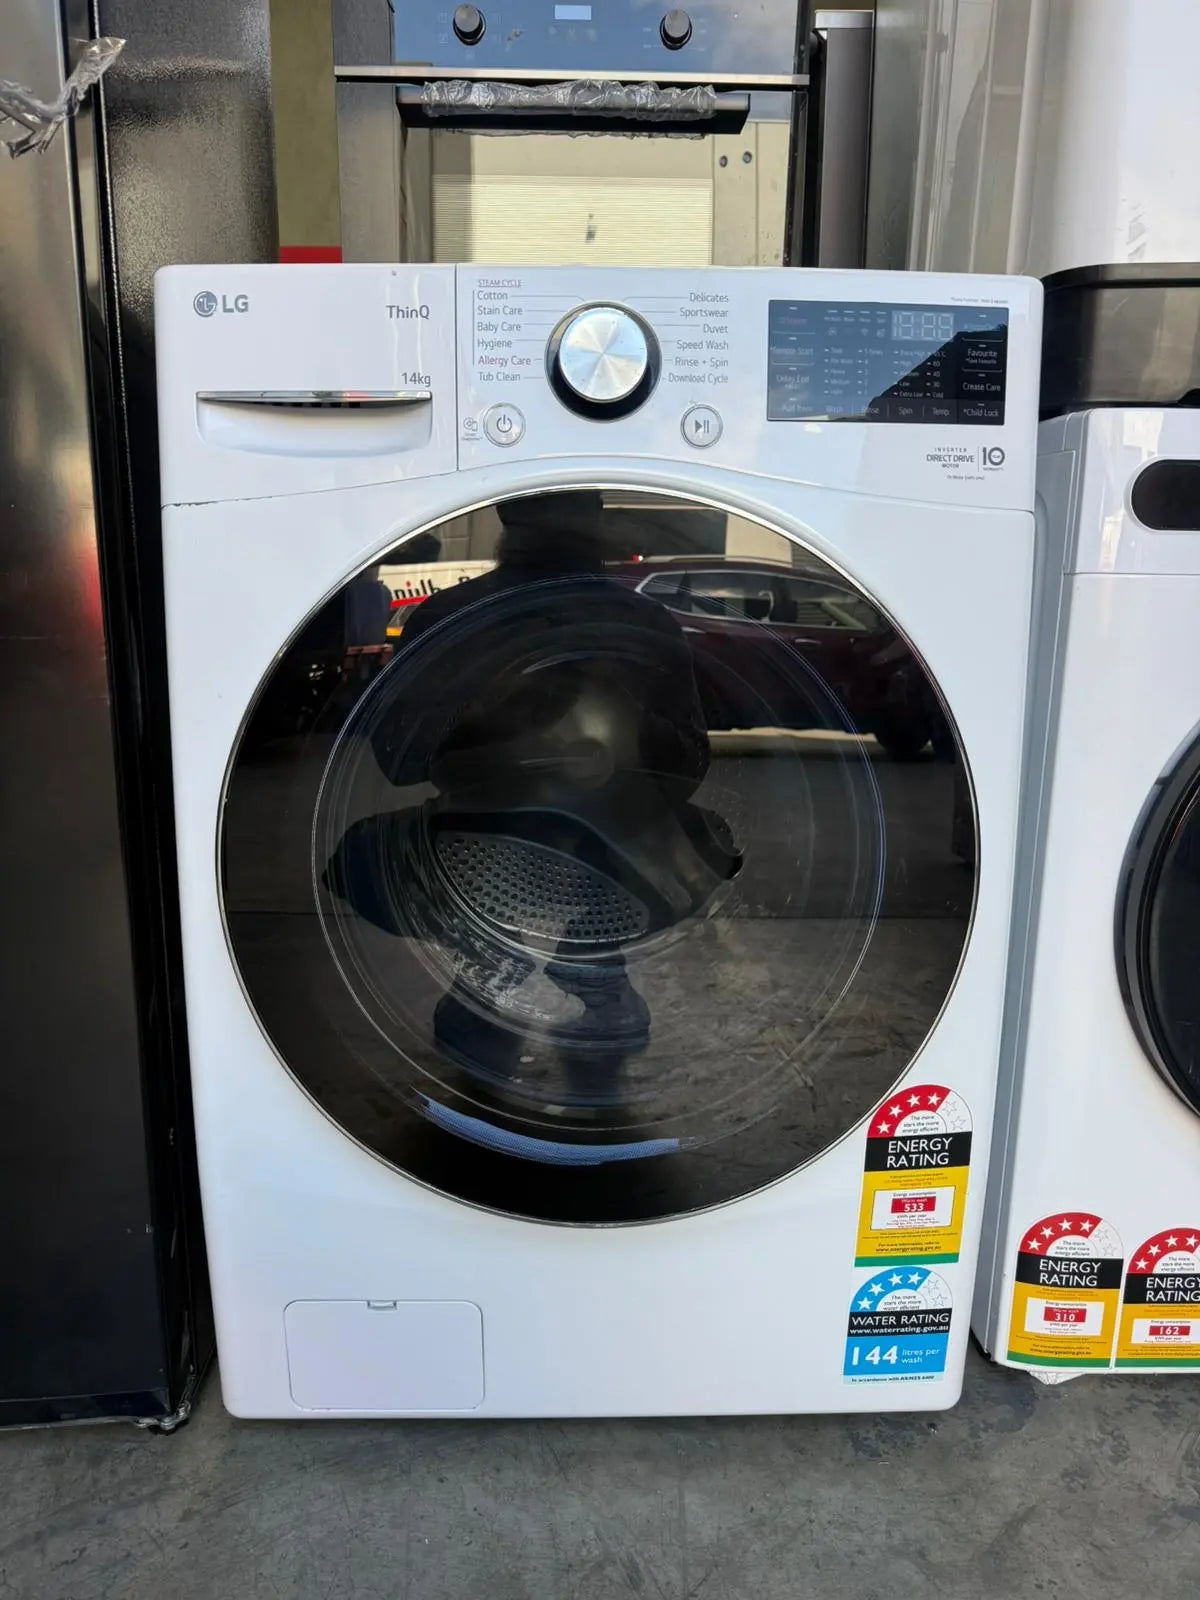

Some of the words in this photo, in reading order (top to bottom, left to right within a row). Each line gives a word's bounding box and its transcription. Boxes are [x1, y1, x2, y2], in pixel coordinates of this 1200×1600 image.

[478, 279, 501, 288] STEAM
[502, 279, 521, 288] CYCLE
[477, 290, 508, 300] Cotton
[689, 292, 729, 303] Delicates
[222, 294, 249, 313] LG
[386, 304, 430, 319] ThinQ
[477, 305, 500, 315] Stain
[502, 305, 523, 315] Care
[679, 307, 729, 318] Sportswear
[477, 322, 499, 333] Baby
[501, 322, 521, 332] Care
[703, 323, 729, 334] Duvet
[477, 338, 513, 350] Hygiene
[676, 340, 704, 351] Speed
[705, 340, 729, 350] Wash
[967, 348, 998, 358] Favourite
[478, 355, 509, 367] Allergy
[511, 355, 531, 365] Care
[675, 356, 700, 367] Rinse
[710, 357, 729, 369] Spin
[402, 372, 431, 387] 14kg
[478, 372, 494, 381] Tub
[496, 372, 521, 381] Clean
[668, 372, 706, 383] Download
[707, 373, 729, 385] Cycle
[962, 382, 985, 391] Crease
[986, 382, 1001, 392] Care
[898, 406, 913, 416] Spin
[932, 407, 950, 417] Temp
[926, 454, 952, 462] DIRECT
[953, 454, 975, 463] DRIVE
[982, 446, 1005, 466] 10
[888, 1137, 953, 1154] ENERGY
[887, 1152, 949, 1169] RATING
[903, 1203, 925, 1212] 533
[1039, 1258, 1102, 1273] ENERGY
[1039, 1272, 1098, 1287] RATING
[1145, 1290, 1200, 1302] RATING
[852, 1315, 897, 1326] WATER
[900, 1313, 949, 1325] RATING
[1055, 1312, 1076, 1321] 310
[849, 1325, 949, 1334] www.waterrating.gov.au
[1158, 1326, 1180, 1335] 162
[851, 1345, 899, 1366] 144
[902, 1348, 924, 1356] litres
[925, 1349, 940, 1357] per
